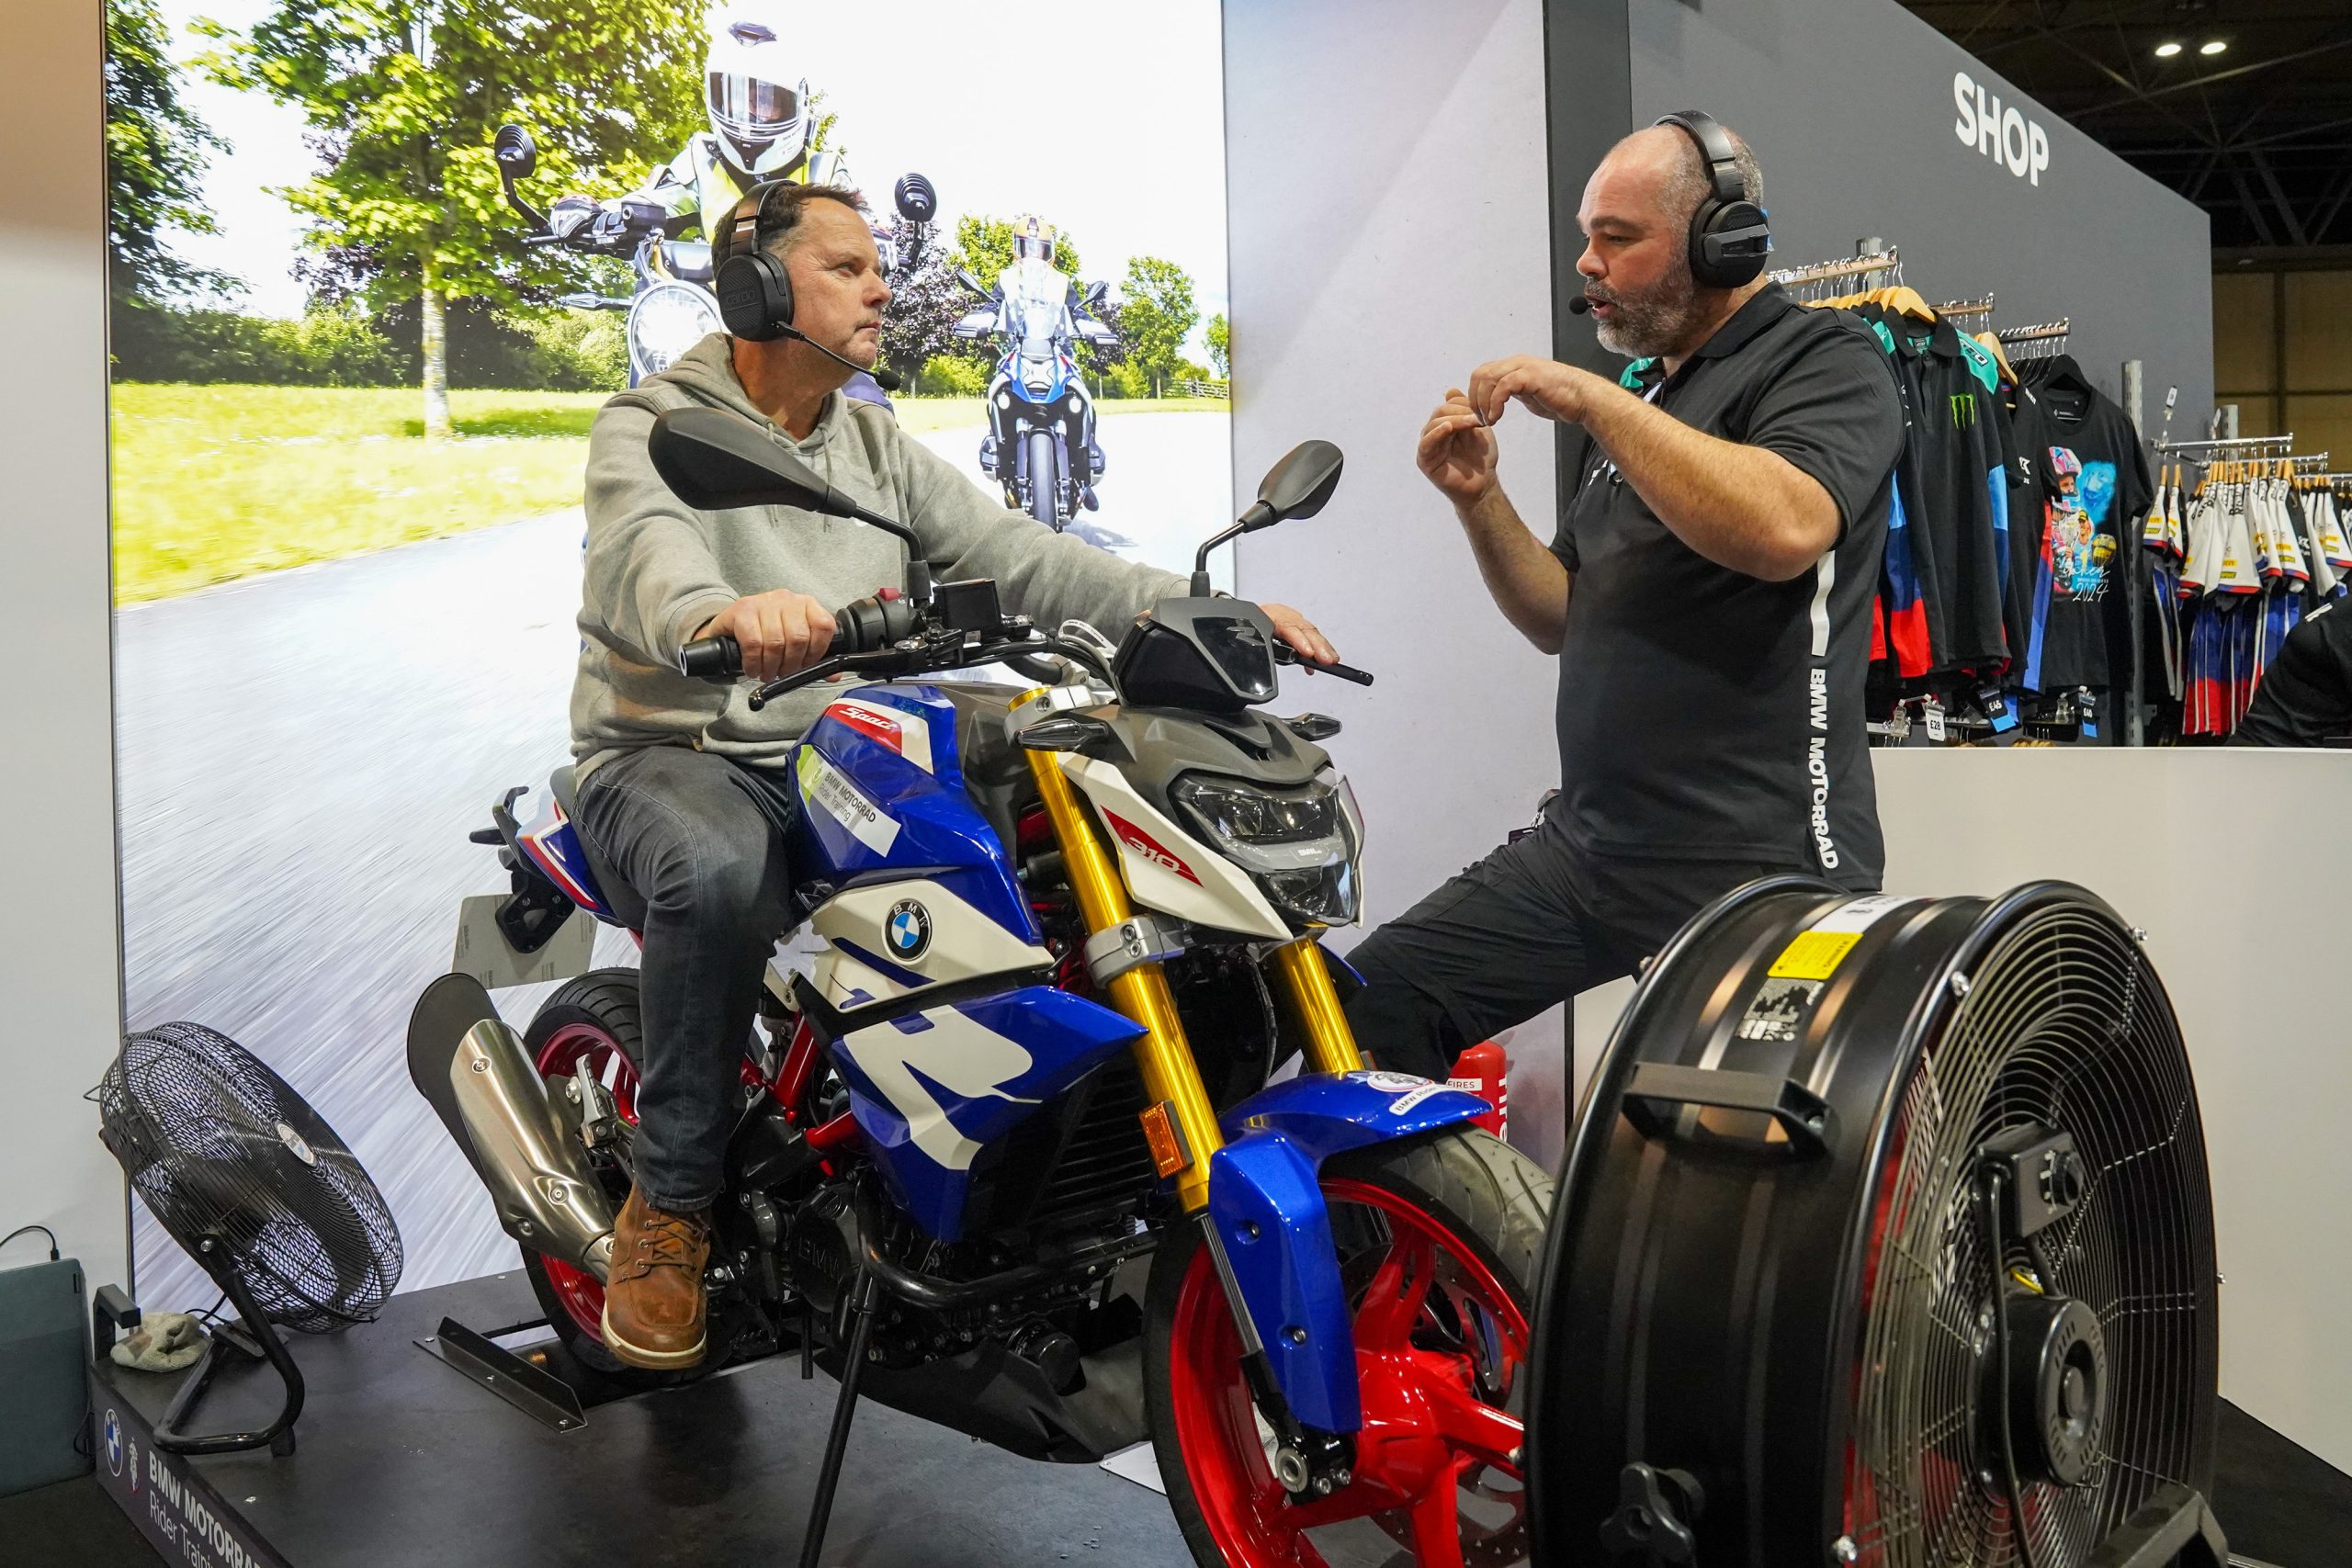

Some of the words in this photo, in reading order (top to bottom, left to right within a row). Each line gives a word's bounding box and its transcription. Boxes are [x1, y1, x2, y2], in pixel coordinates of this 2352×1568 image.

[1953, 72, 2050, 187] SHOP
[2072, 582, 2109, 603] 2024
[1810, 669, 1828, 730] BMW
[818, 783, 831, 801] Rider
[831, 795, 852, 822] Training
[824, 772, 842, 791] BMW
[838, 785, 876, 822] MOTORRAD
[1808, 738, 1839, 869] MOTORRAD
[1125, 836, 1181, 872] 310
[149, 1450, 182, 1509] BMW
[185, 1489, 262, 1568] MOTORRA
[150, 1489, 177, 1544] Rider
